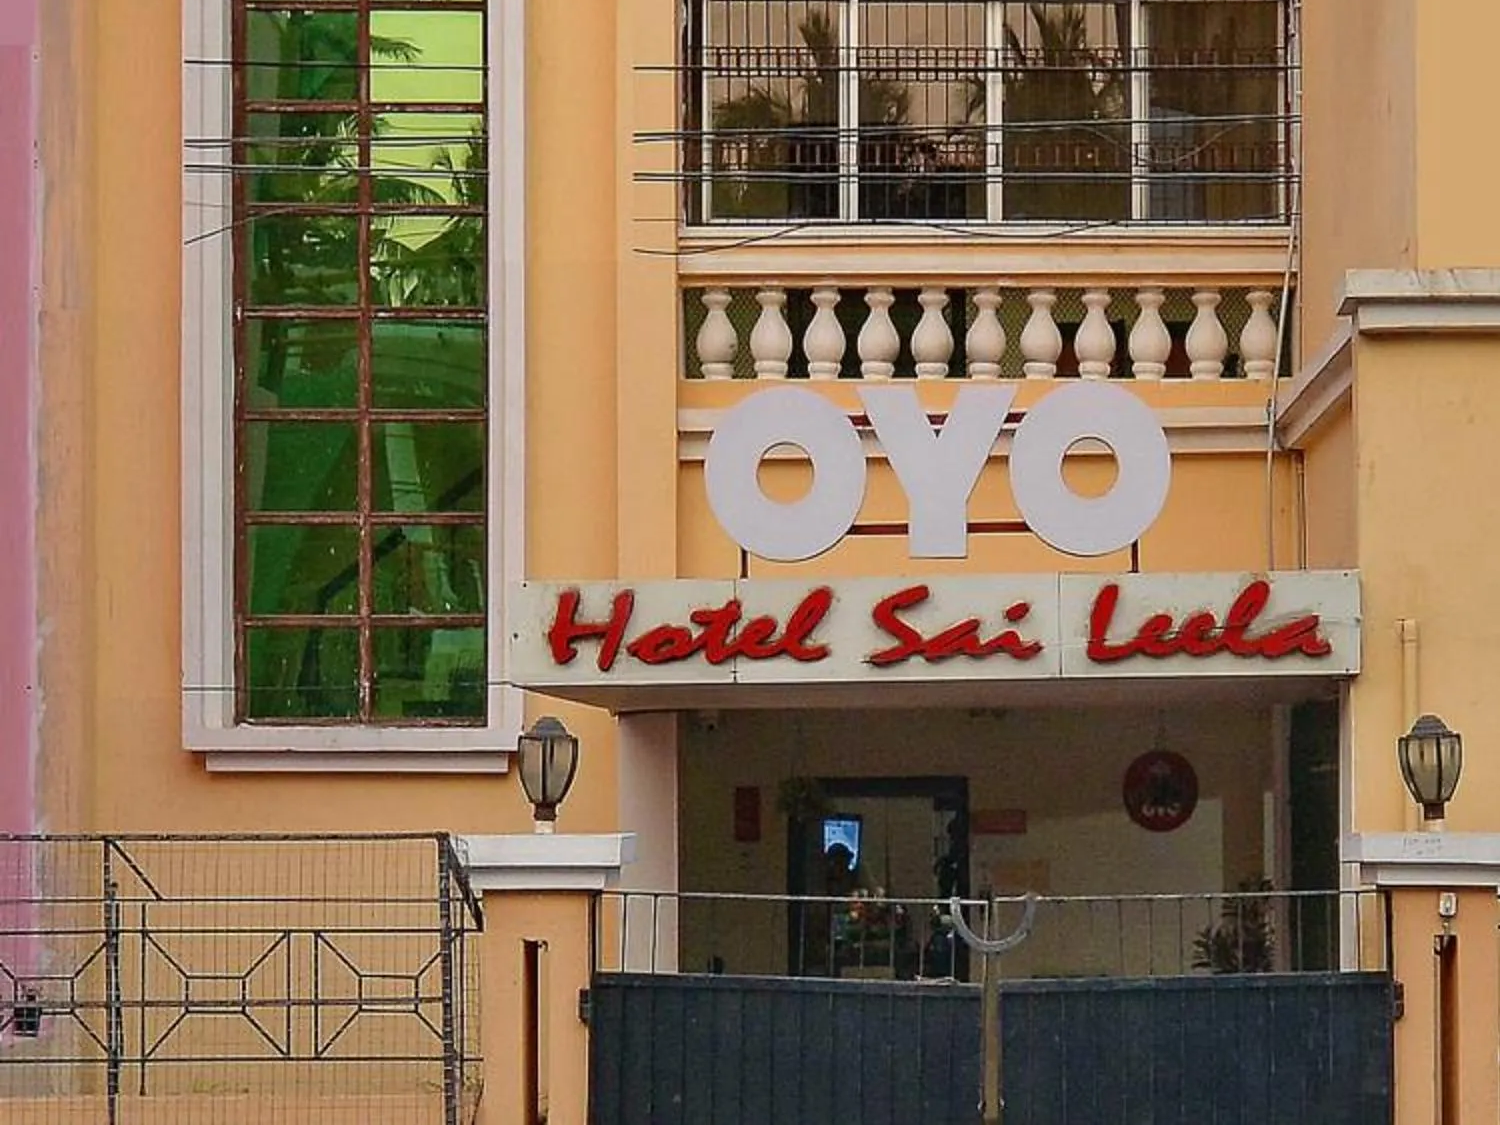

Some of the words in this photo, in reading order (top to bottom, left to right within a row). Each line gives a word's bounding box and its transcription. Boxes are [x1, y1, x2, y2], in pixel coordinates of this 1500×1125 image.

[704, 382, 1171, 562] OYO
[548, 584, 834, 672] Hotel
[864, 584, 1044, 667] Sai
[1086, 580, 1333, 663] Leela
